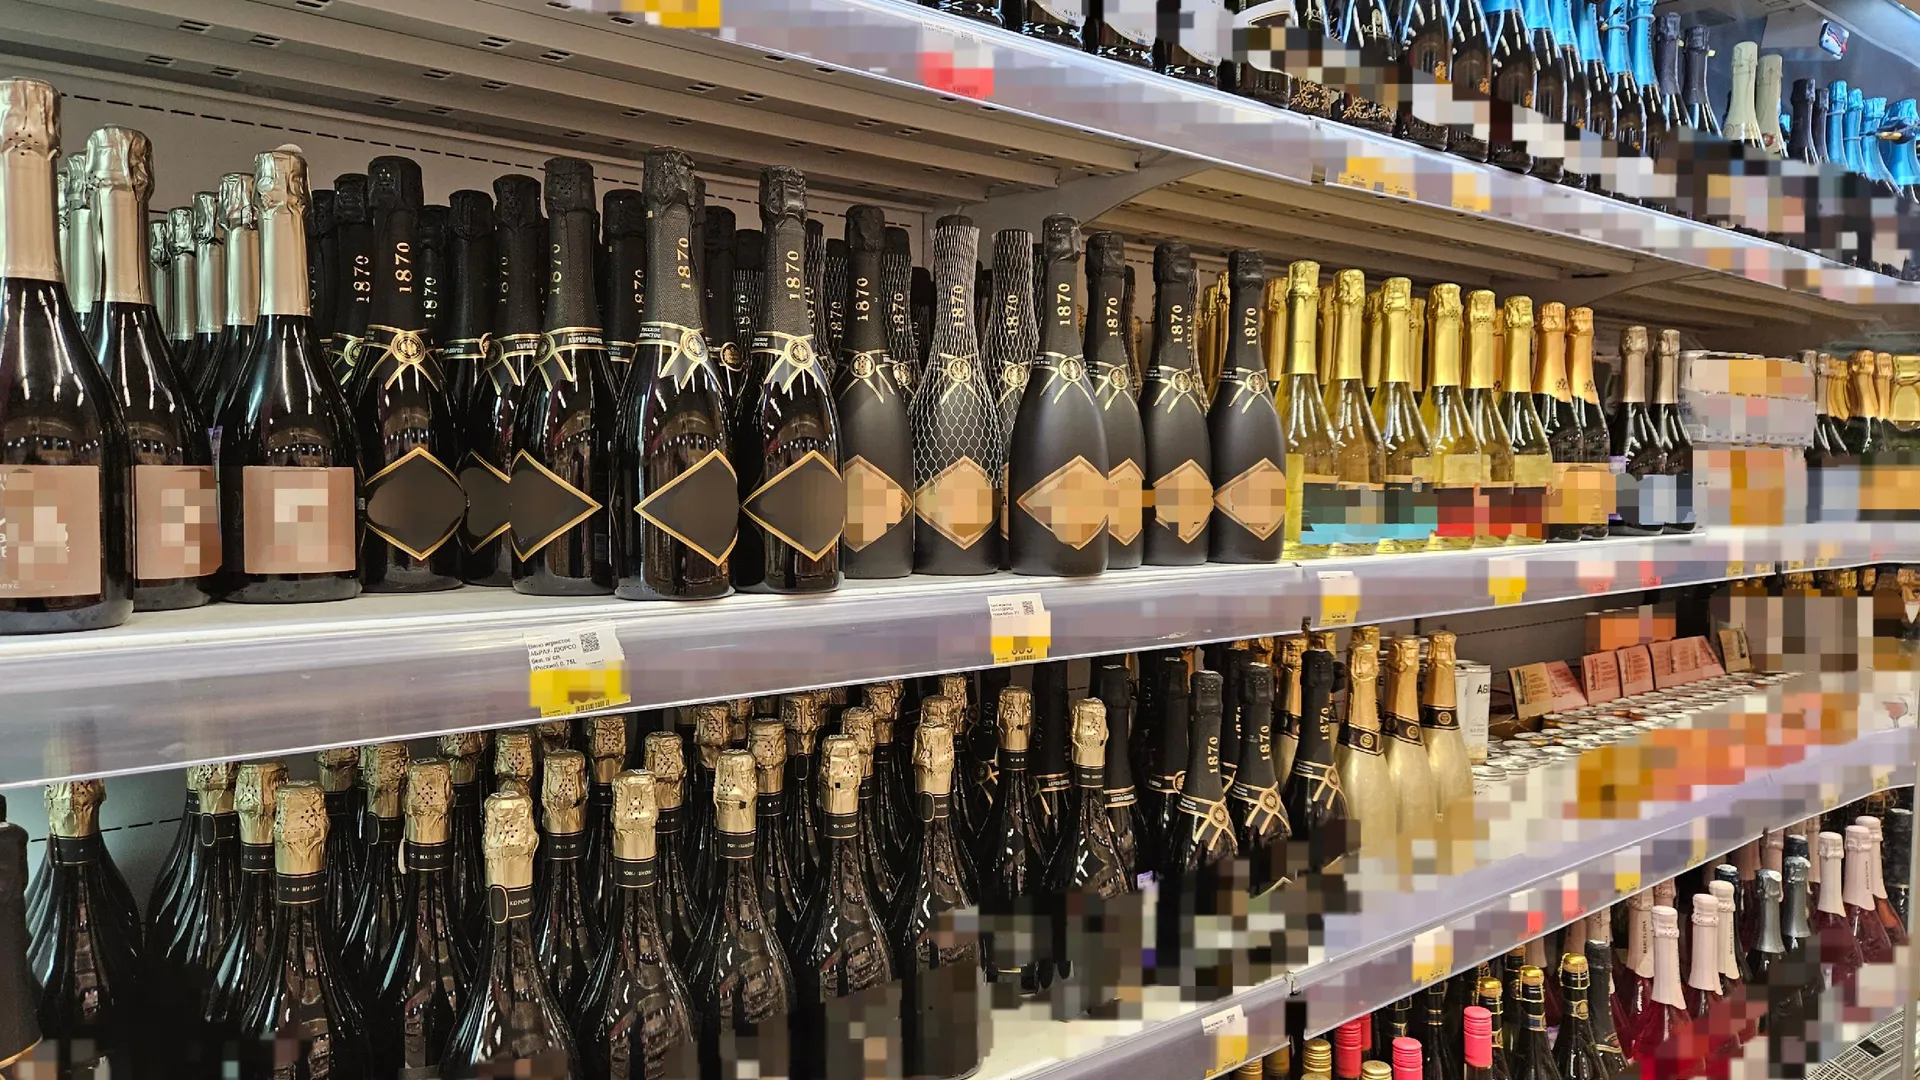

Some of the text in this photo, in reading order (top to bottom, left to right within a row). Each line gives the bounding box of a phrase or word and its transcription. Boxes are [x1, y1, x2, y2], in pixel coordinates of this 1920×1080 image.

[353, 255, 371, 303] 1870
[395, 242, 413, 293] 1870
[677, 237, 692, 291] 1870
[786, 250, 801, 301] 1870
[423, 276, 438, 319] 1870
[855, 277, 870, 321] 1870
[892, 292, 905, 333] 1870
[951, 284, 965, 328] 1870
[1005, 294, 1019, 335] 1870
[1056, 283, 1072, 326] 1870
[1106, 297, 1119, 337] 1870
[830, 301, 844, 340] 1870
[1171, 304, 1184, 343] 1870
[1244, 307, 1257, 345] 1870
[1258, 725, 1271, 761] 1870
[1319, 707, 1330, 741] 1870
[1207, 736, 1219, 774] 1870
